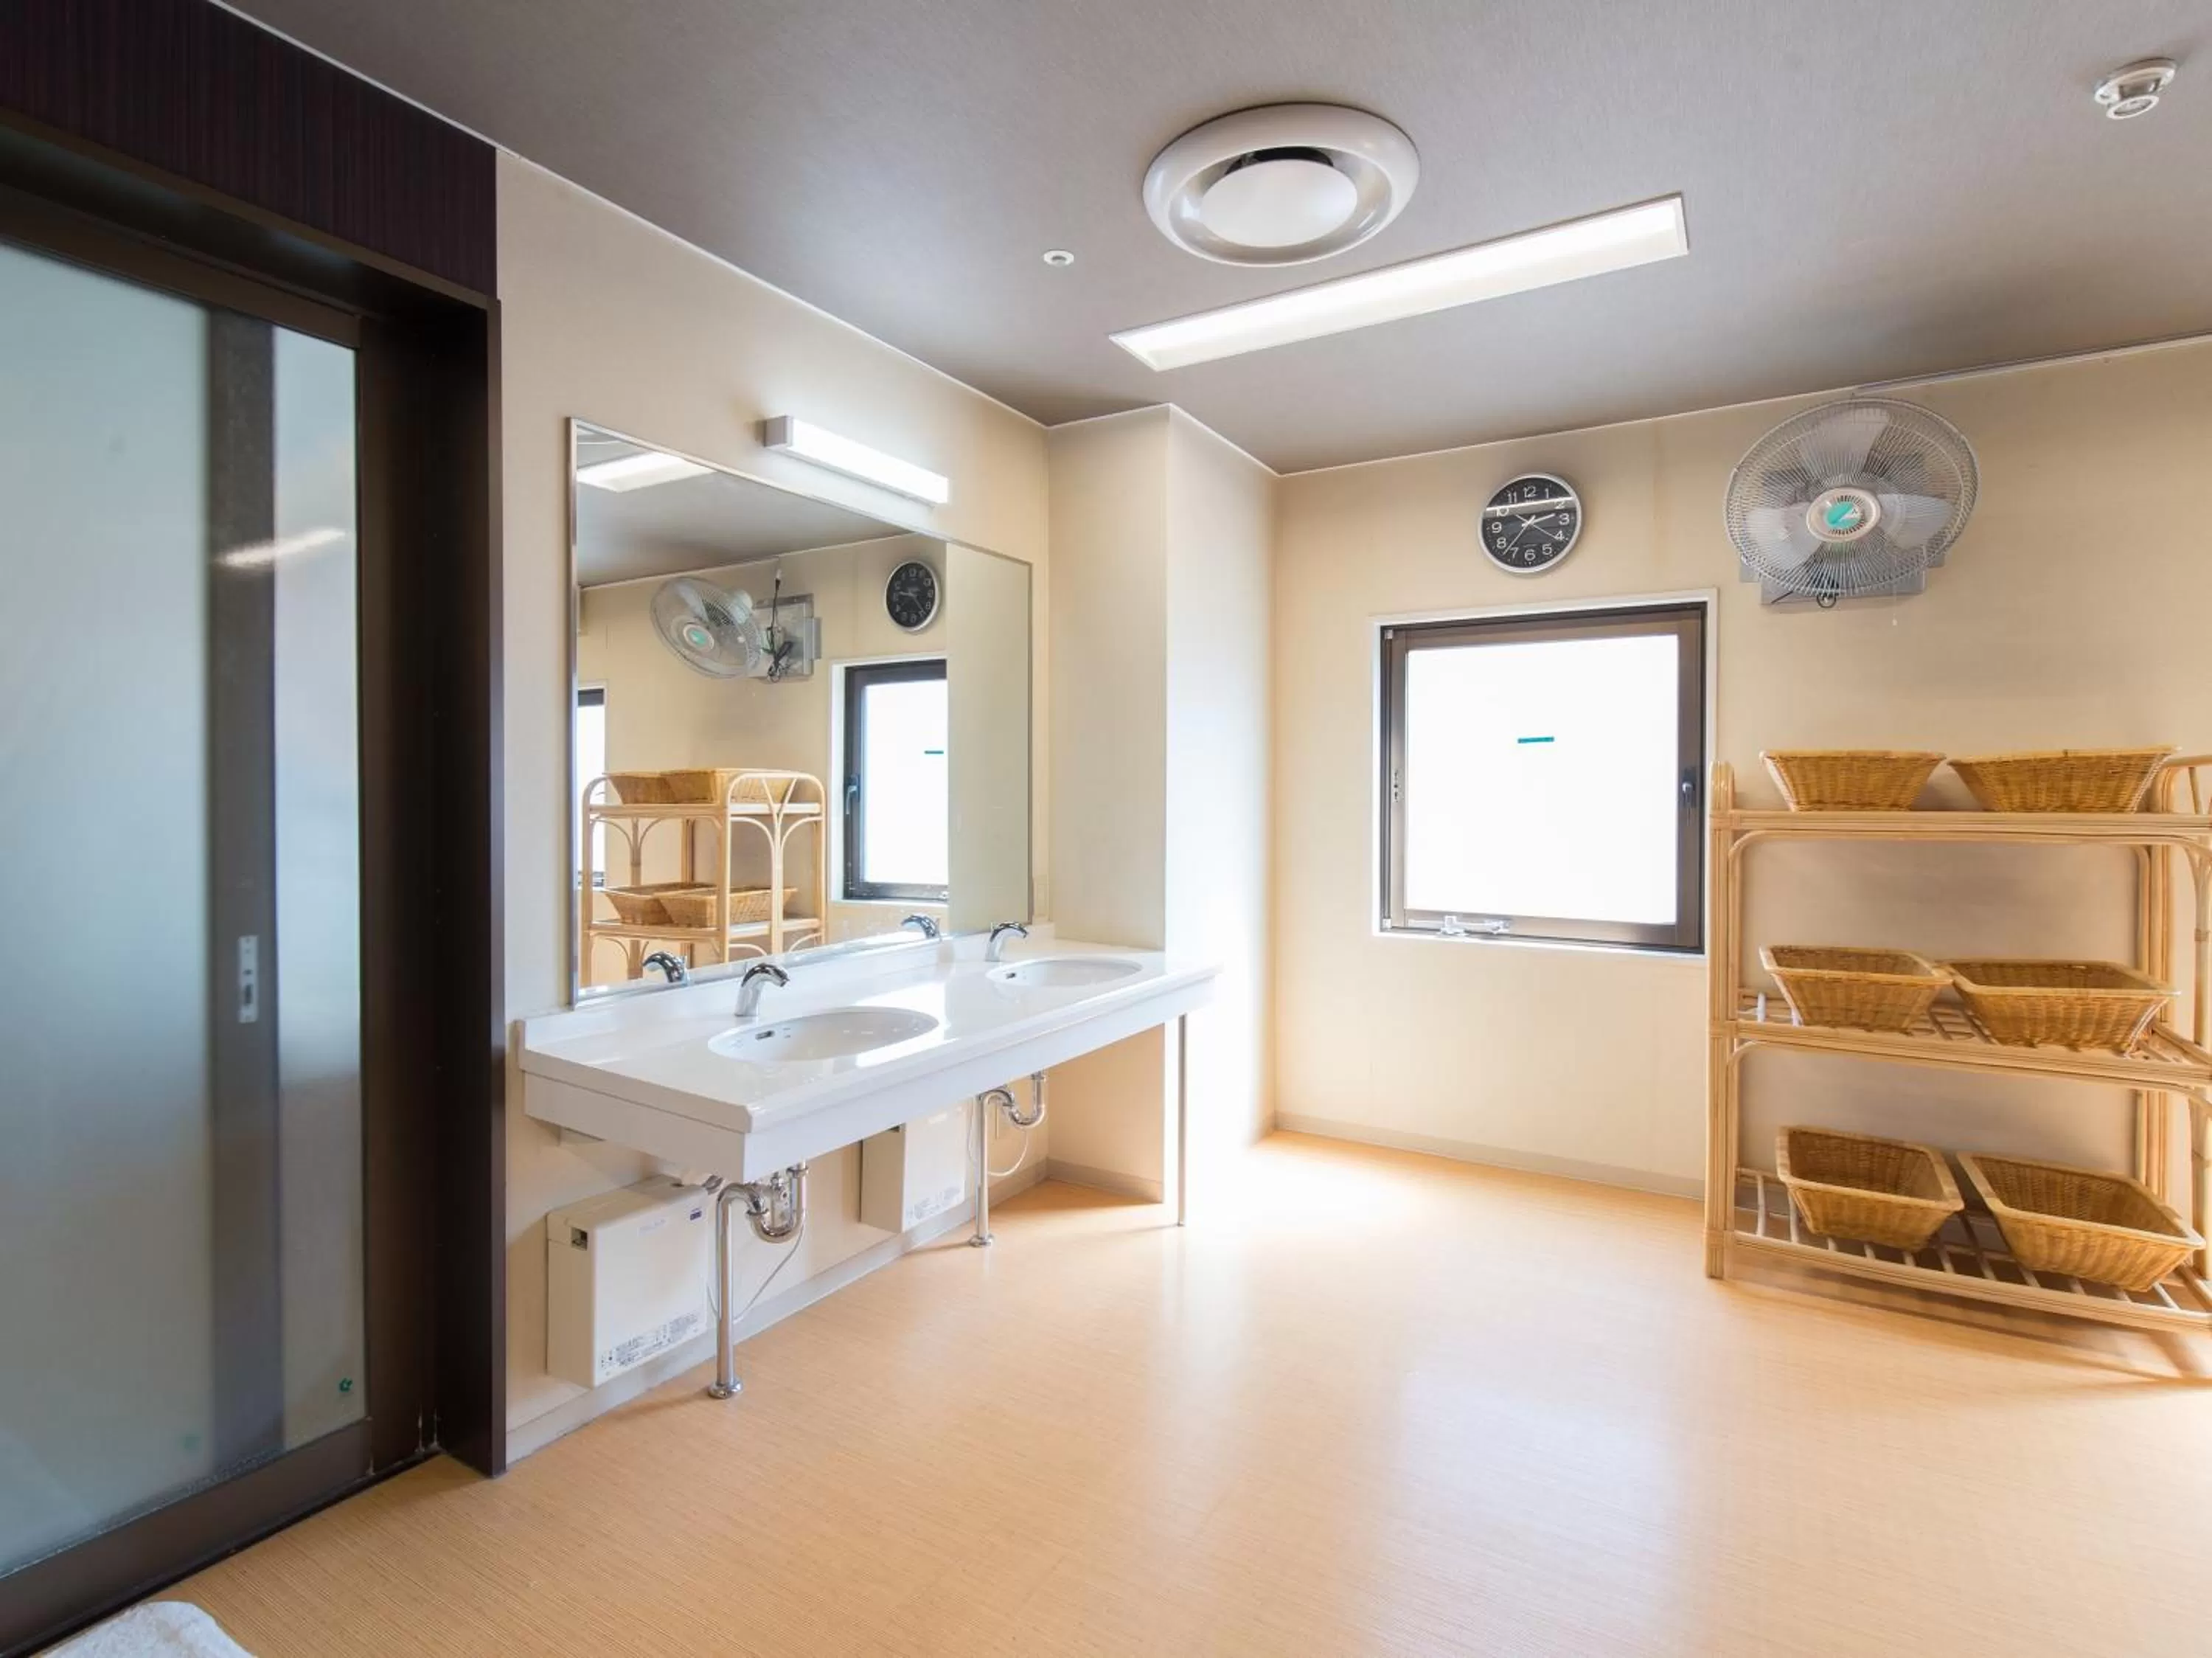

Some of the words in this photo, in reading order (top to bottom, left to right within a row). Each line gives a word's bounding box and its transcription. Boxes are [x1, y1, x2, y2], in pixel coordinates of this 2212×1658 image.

[1523, 486, 1537, 498] 12
[1544, 488, 1550, 499] 1
[1508, 492, 1517, 504] 11
[1554, 500, 1565, 509] 2
[1496, 507, 1509, 517] 10
[1559, 513, 1570, 525] 3
[1492, 521, 1502, 533] 9
[1554, 530, 1565, 541] 4
[1496, 537, 1506, 549] 8
[1510, 547, 1519, 558] 7
[1524, 549, 1536, 561] 6
[1542, 544, 1552, 555] 5
